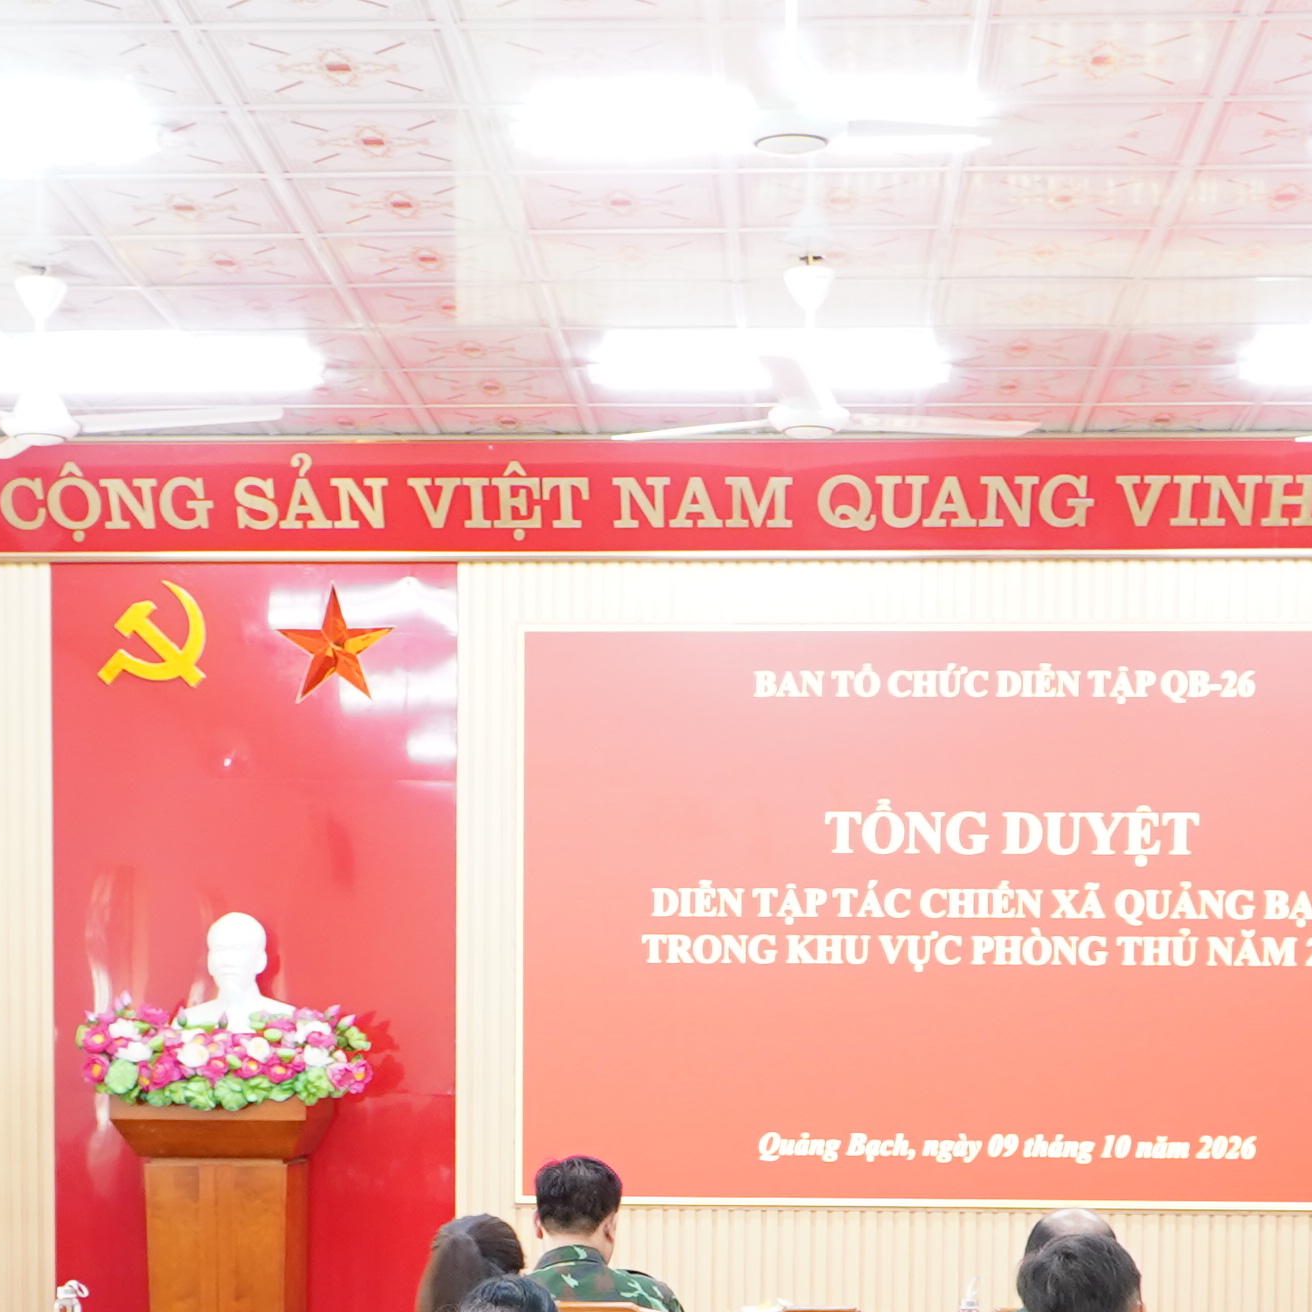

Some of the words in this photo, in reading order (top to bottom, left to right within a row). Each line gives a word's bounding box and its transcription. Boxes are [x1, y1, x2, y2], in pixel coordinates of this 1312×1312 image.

[235, 453, 388, 530] SẢN
[407, 461, 590, 542] VIỆT
[613, 476, 794, 529] NAM
[817, 473, 1095, 530] QUANG
[753, 670, 825, 698] BAN
[830, 663, 881, 698] TỔ
[887, 663, 989, 698] CHỨC
[995, 663, 1082, 698] DIỄN
[1087, 666, 1157, 705] TẬP
[1160, 669, 1256, 704] QB-26
[824, 798, 990, 856] TỔNG
[1001, 804, 1200, 868] DUYỆT
[651, 879, 745, 918] DIỄN
[751, 883, 828, 926] TẬP
[831, 879, 912, 919] TÁC
[919, 880, 1044, 919] CHIẾN
[1050, 881, 1106, 919] XÃ
[1114, 880, 1256, 927] QUẢNG
[641, 933, 778, 965] TRONG
[785, 934, 872, 965] KHU
[878, 930, 963, 973] VỰC
[970, 926, 1109, 967] PHÒNG
[1116, 927, 1199, 967] THỦ
[1206, 928, 1298, 967] NĂM
[758, 1131, 842, 1163] Quảng
[846, 1132, 917, 1163] Bạch,
[922, 1132, 983, 1164] ngày
[988, 1134, 1020, 1158] 09
[1023, 1133, 1095, 1165] tháng
[1100, 1134, 1131, 1159] 10
[1135, 1135, 1189, 1160] năm
[1195, 1135, 1257, 1160] 2026
